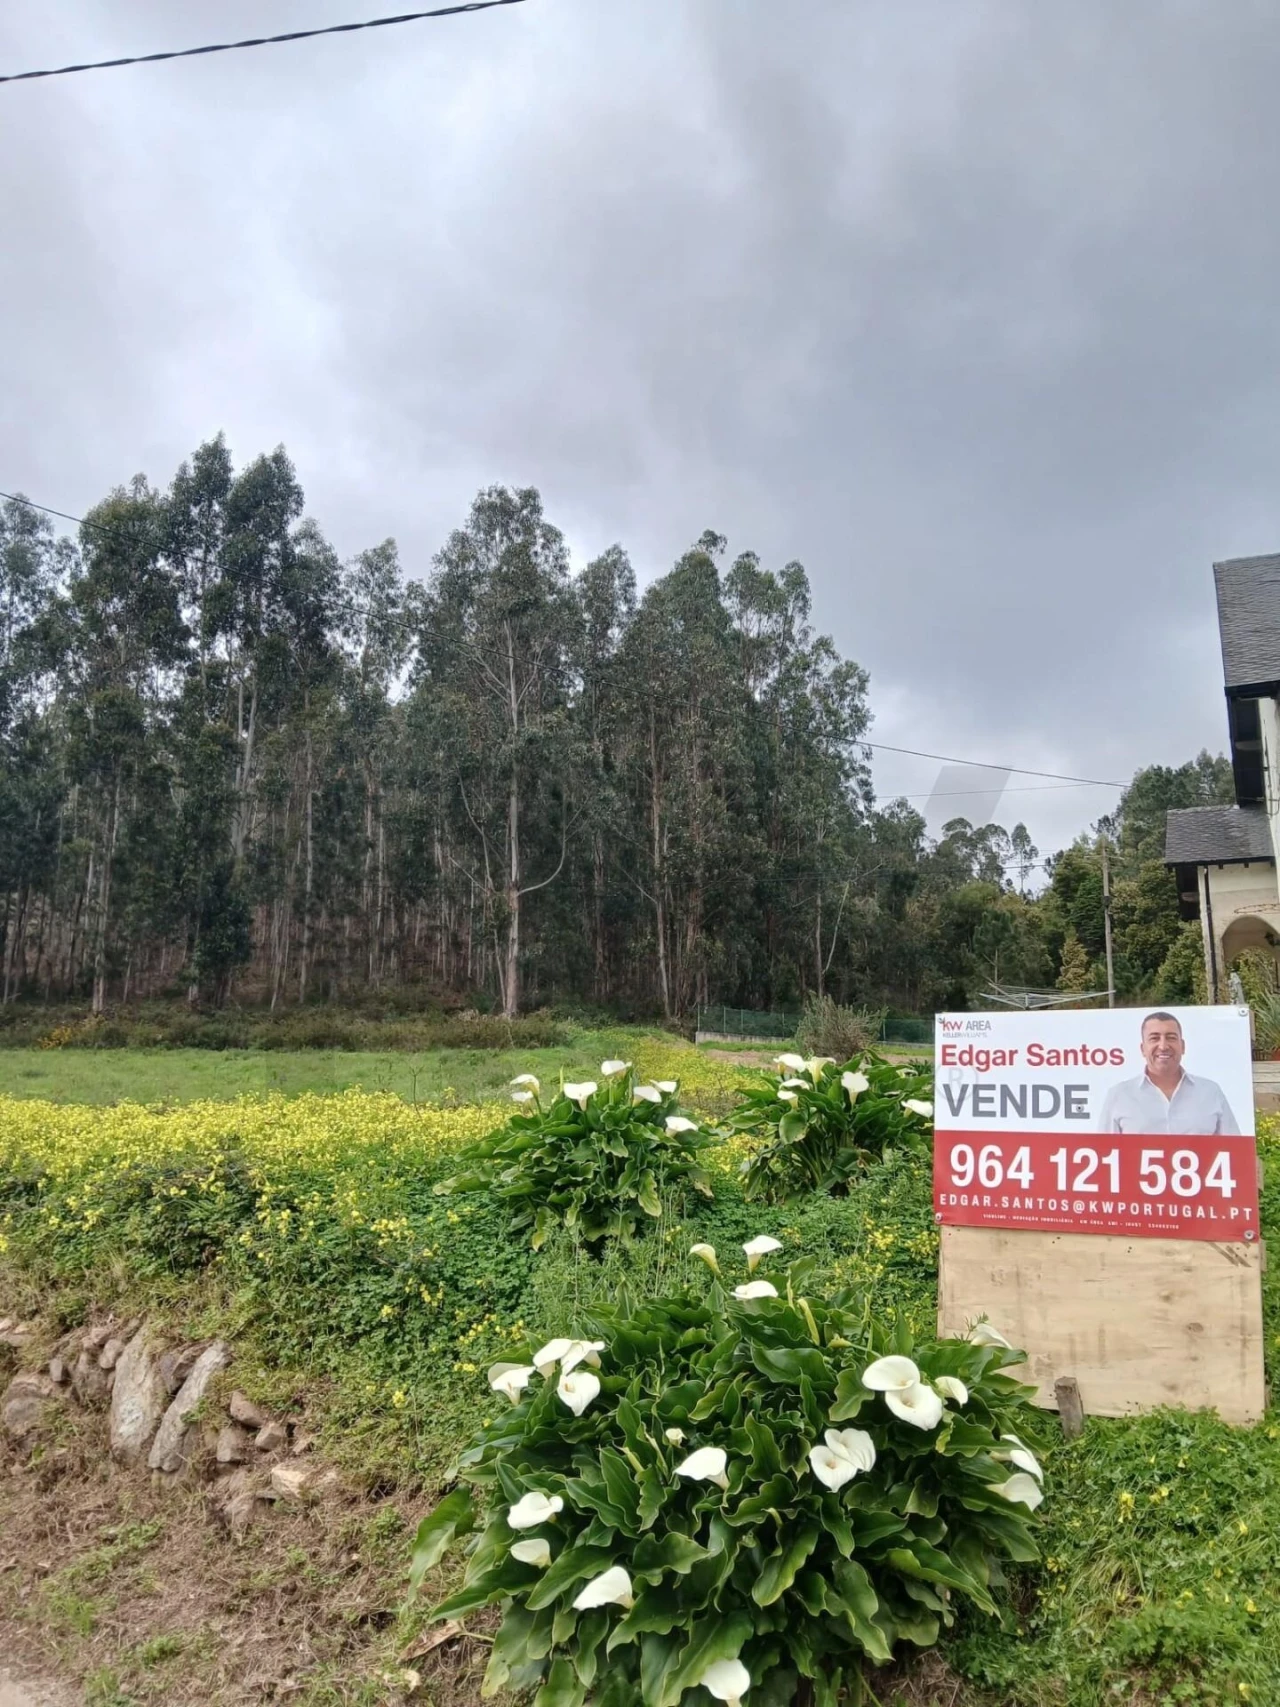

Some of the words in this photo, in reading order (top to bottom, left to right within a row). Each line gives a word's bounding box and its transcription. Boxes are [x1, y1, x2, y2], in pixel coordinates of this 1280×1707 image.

[941, 1044, 1018, 1072] Edgar
[1026, 1043, 1125, 1066] Santos
[943, 1083, 1090, 1119] VENDE
[949, 1143, 1035, 1190] 964
[1049, 1147, 1120, 1193] 121
[1139, 1149, 1237, 1198] 584
[939, 1193, 1253, 1221] EDGAR.SANTOS@KWPORTUGAL.PT
